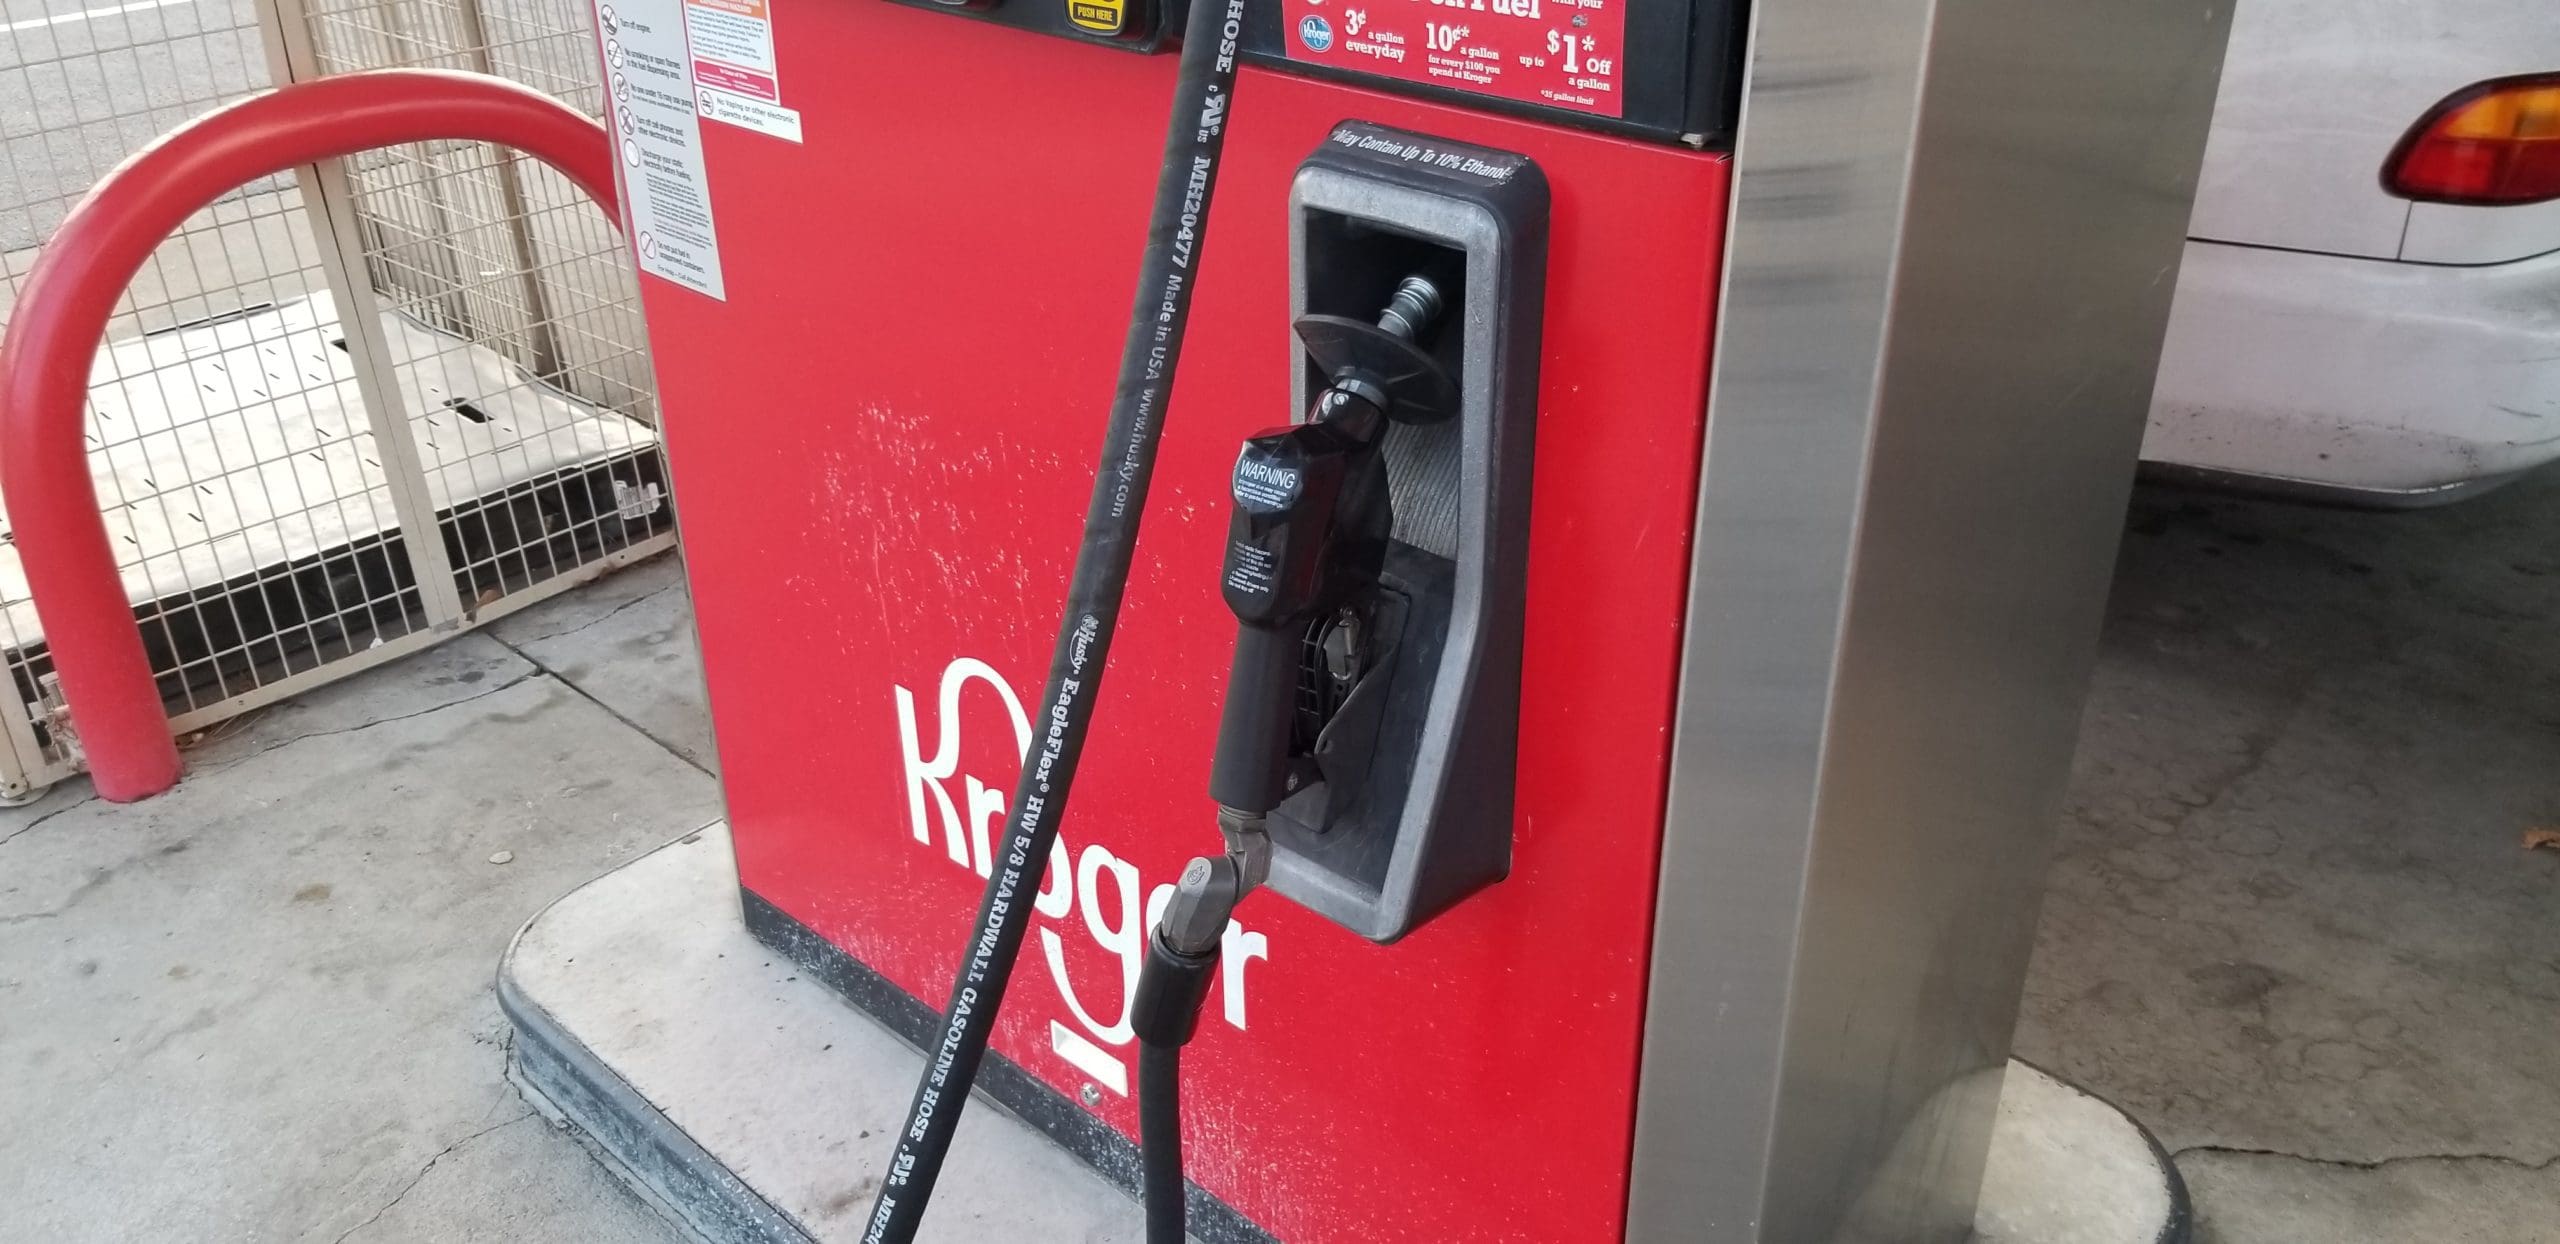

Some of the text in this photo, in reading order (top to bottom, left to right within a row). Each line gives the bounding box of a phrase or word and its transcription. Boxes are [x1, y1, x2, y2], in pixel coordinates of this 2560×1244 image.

[1077, 6, 1113, 22] PUSH HERE
[1215, 0, 1244, 73] HOSE
[1303, 20, 1331, 48] Kroger
[1367, 31, 1404, 45] a gallon
[1345, 40, 1405, 63] everyday
[1428, 54, 1501, 75] for every $100 you
[1460, 46, 1500, 60] a gallon
[1519, 55, 1533, 68] up
[1534, 57, 1545, 68] to
[1586, 58, 1612, 76] Off
[1428, 66, 1492, 84] spend at Kroger
[1567, 77, 1611, 92] a gallon
[1553, 92, 1576, 103] gallon
[1576, 95, 1595, 106] limit
[1333, 129, 1511, 180] May Contain Up To 10% Ethanol
[1172, 156, 1211, 269] MH20477
[1159, 274, 1183, 323] Made
[1155, 325, 1172, 342] in
[1146, 346, 1166, 381] USA
[1111, 388, 1155, 517] www.husky.com
[1240, 459, 1296, 489] WARNING
[1020, 794, 1045, 834] HW
[1008, 834, 1032, 867] 5/8
[967, 867, 1020, 983] HARDWALL
[930, 987, 978, 1088] GASOLINE
[909, 1086, 940, 1143] HOSE
